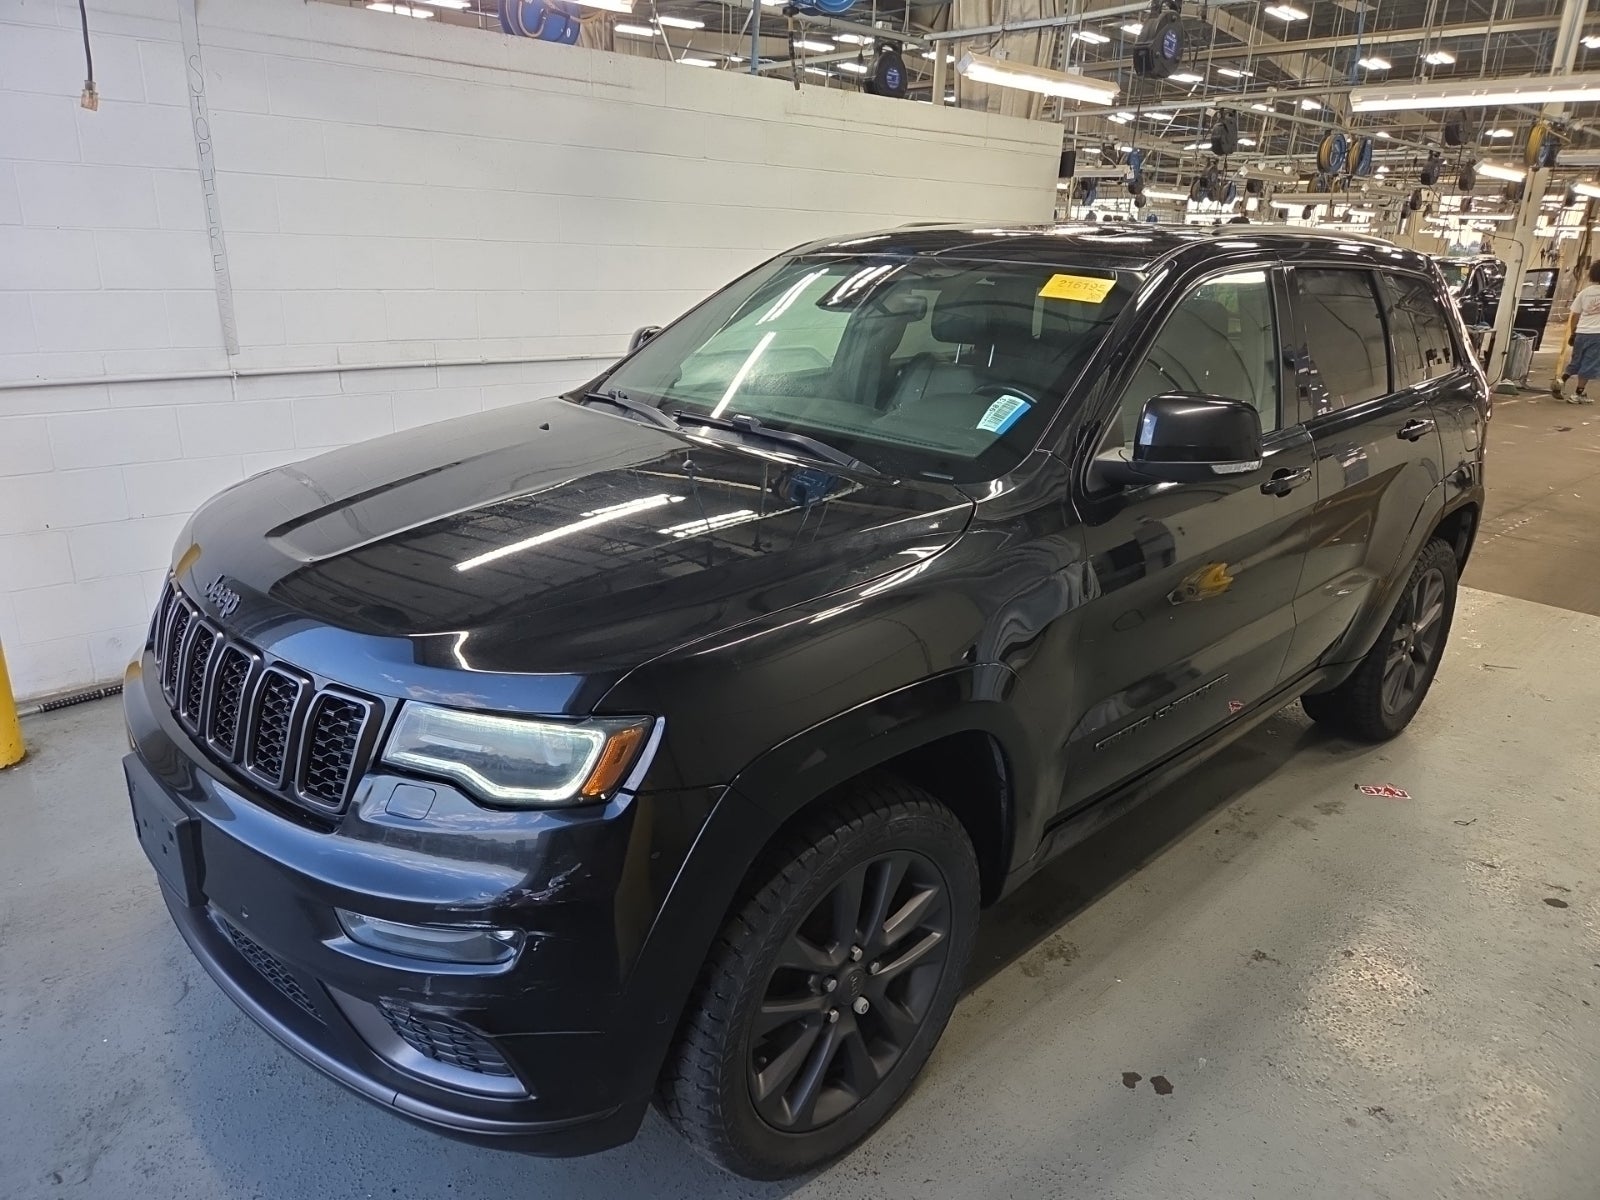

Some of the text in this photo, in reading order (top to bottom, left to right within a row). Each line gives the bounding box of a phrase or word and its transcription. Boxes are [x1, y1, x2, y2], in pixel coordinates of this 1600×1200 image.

[188, 54, 225, 272] STOP HERE
[205, 573, 241, 619] Jeep
